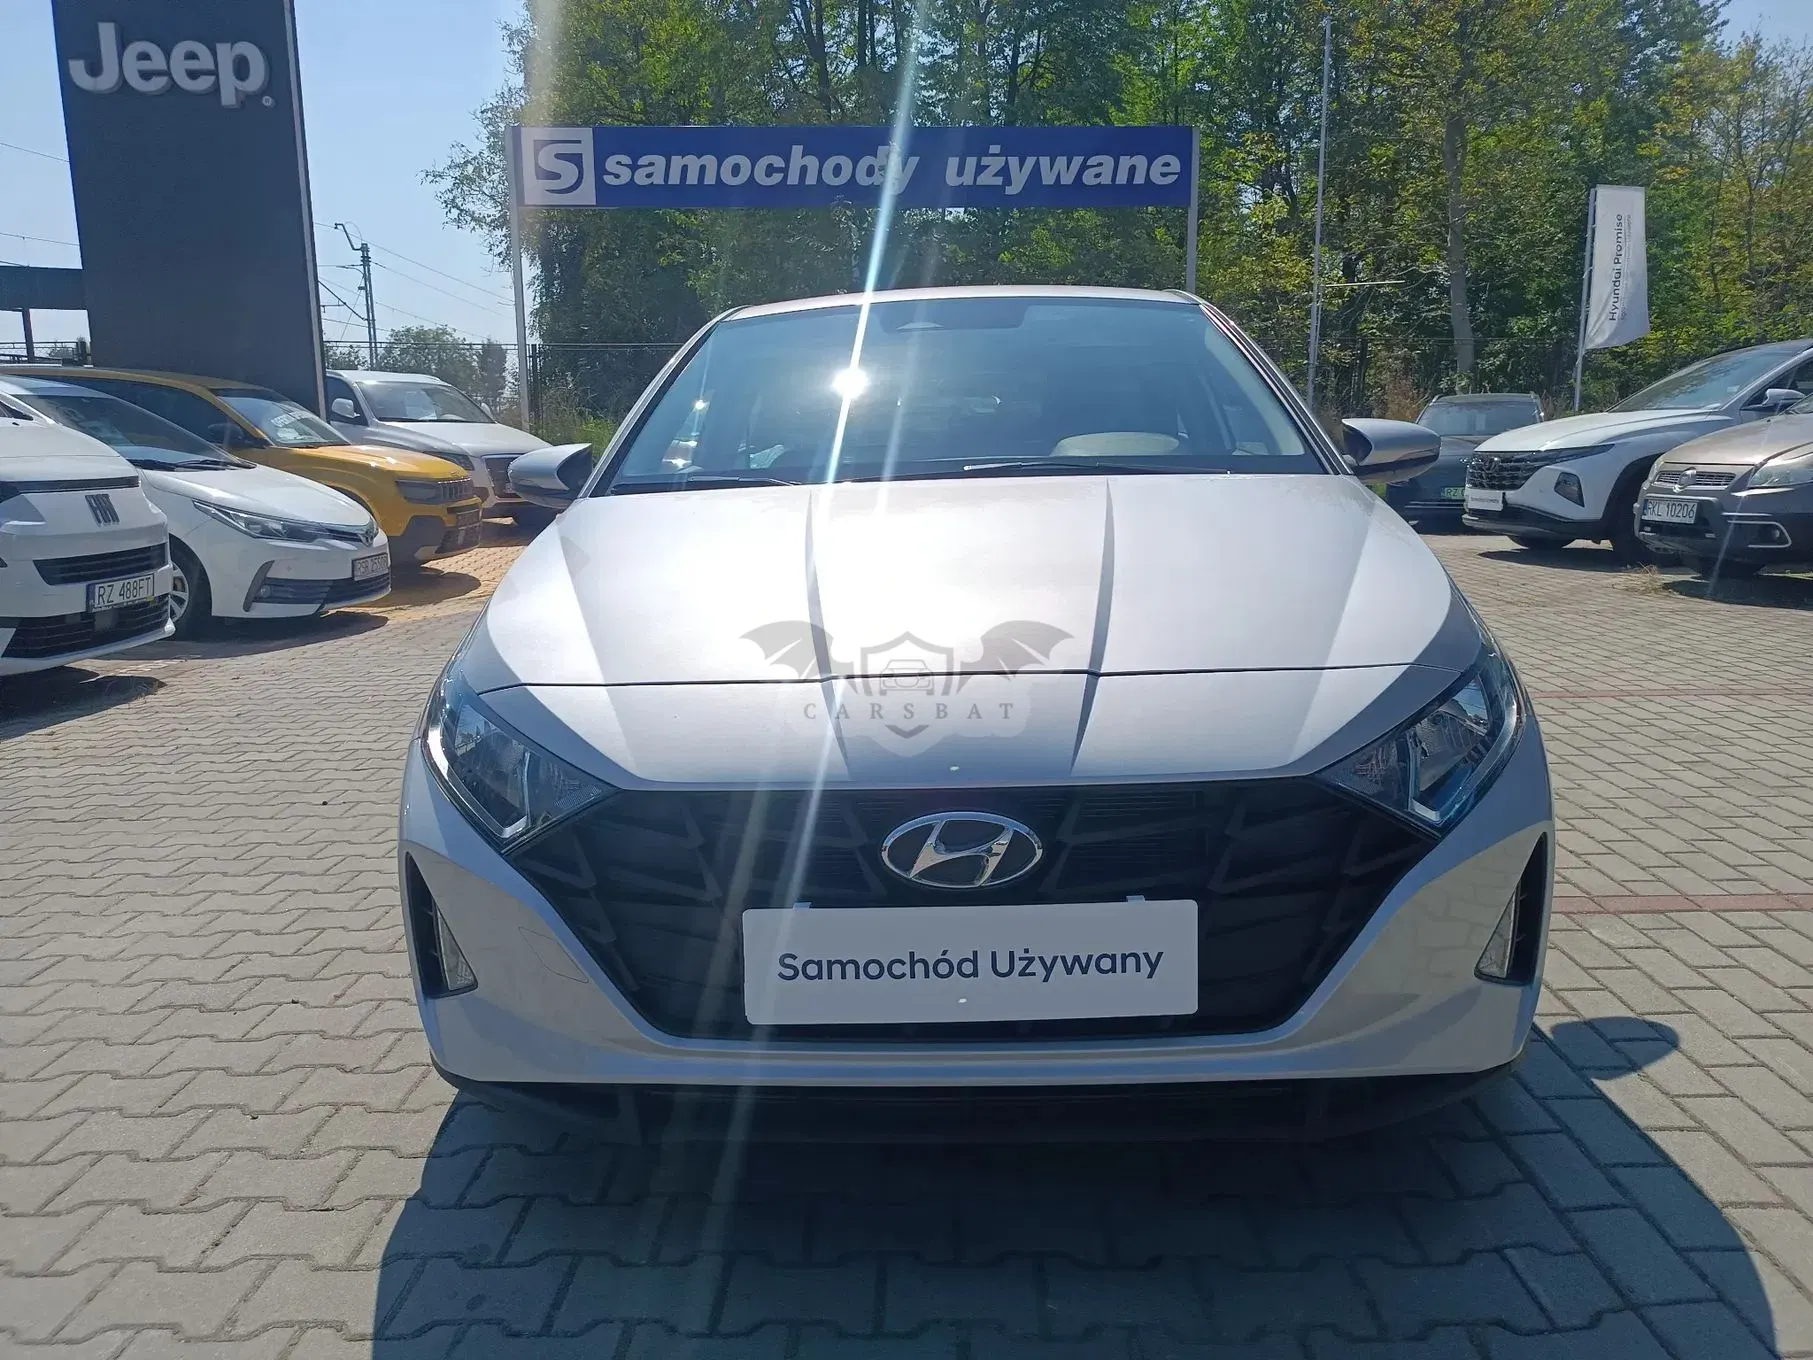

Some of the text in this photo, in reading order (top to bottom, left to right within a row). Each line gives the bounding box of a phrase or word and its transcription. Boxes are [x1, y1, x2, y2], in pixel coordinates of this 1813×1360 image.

[68, 21, 268, 108] Jeep
[602, 144, 1181, 196] samochody używane
[1609, 213, 1623, 321] Hyundai Promise
[1648, 501, 1696, 519] RKL 10206
[97, 576, 152, 606] RZ 488FT
[776, 946, 1165, 983] Samochód Używany
